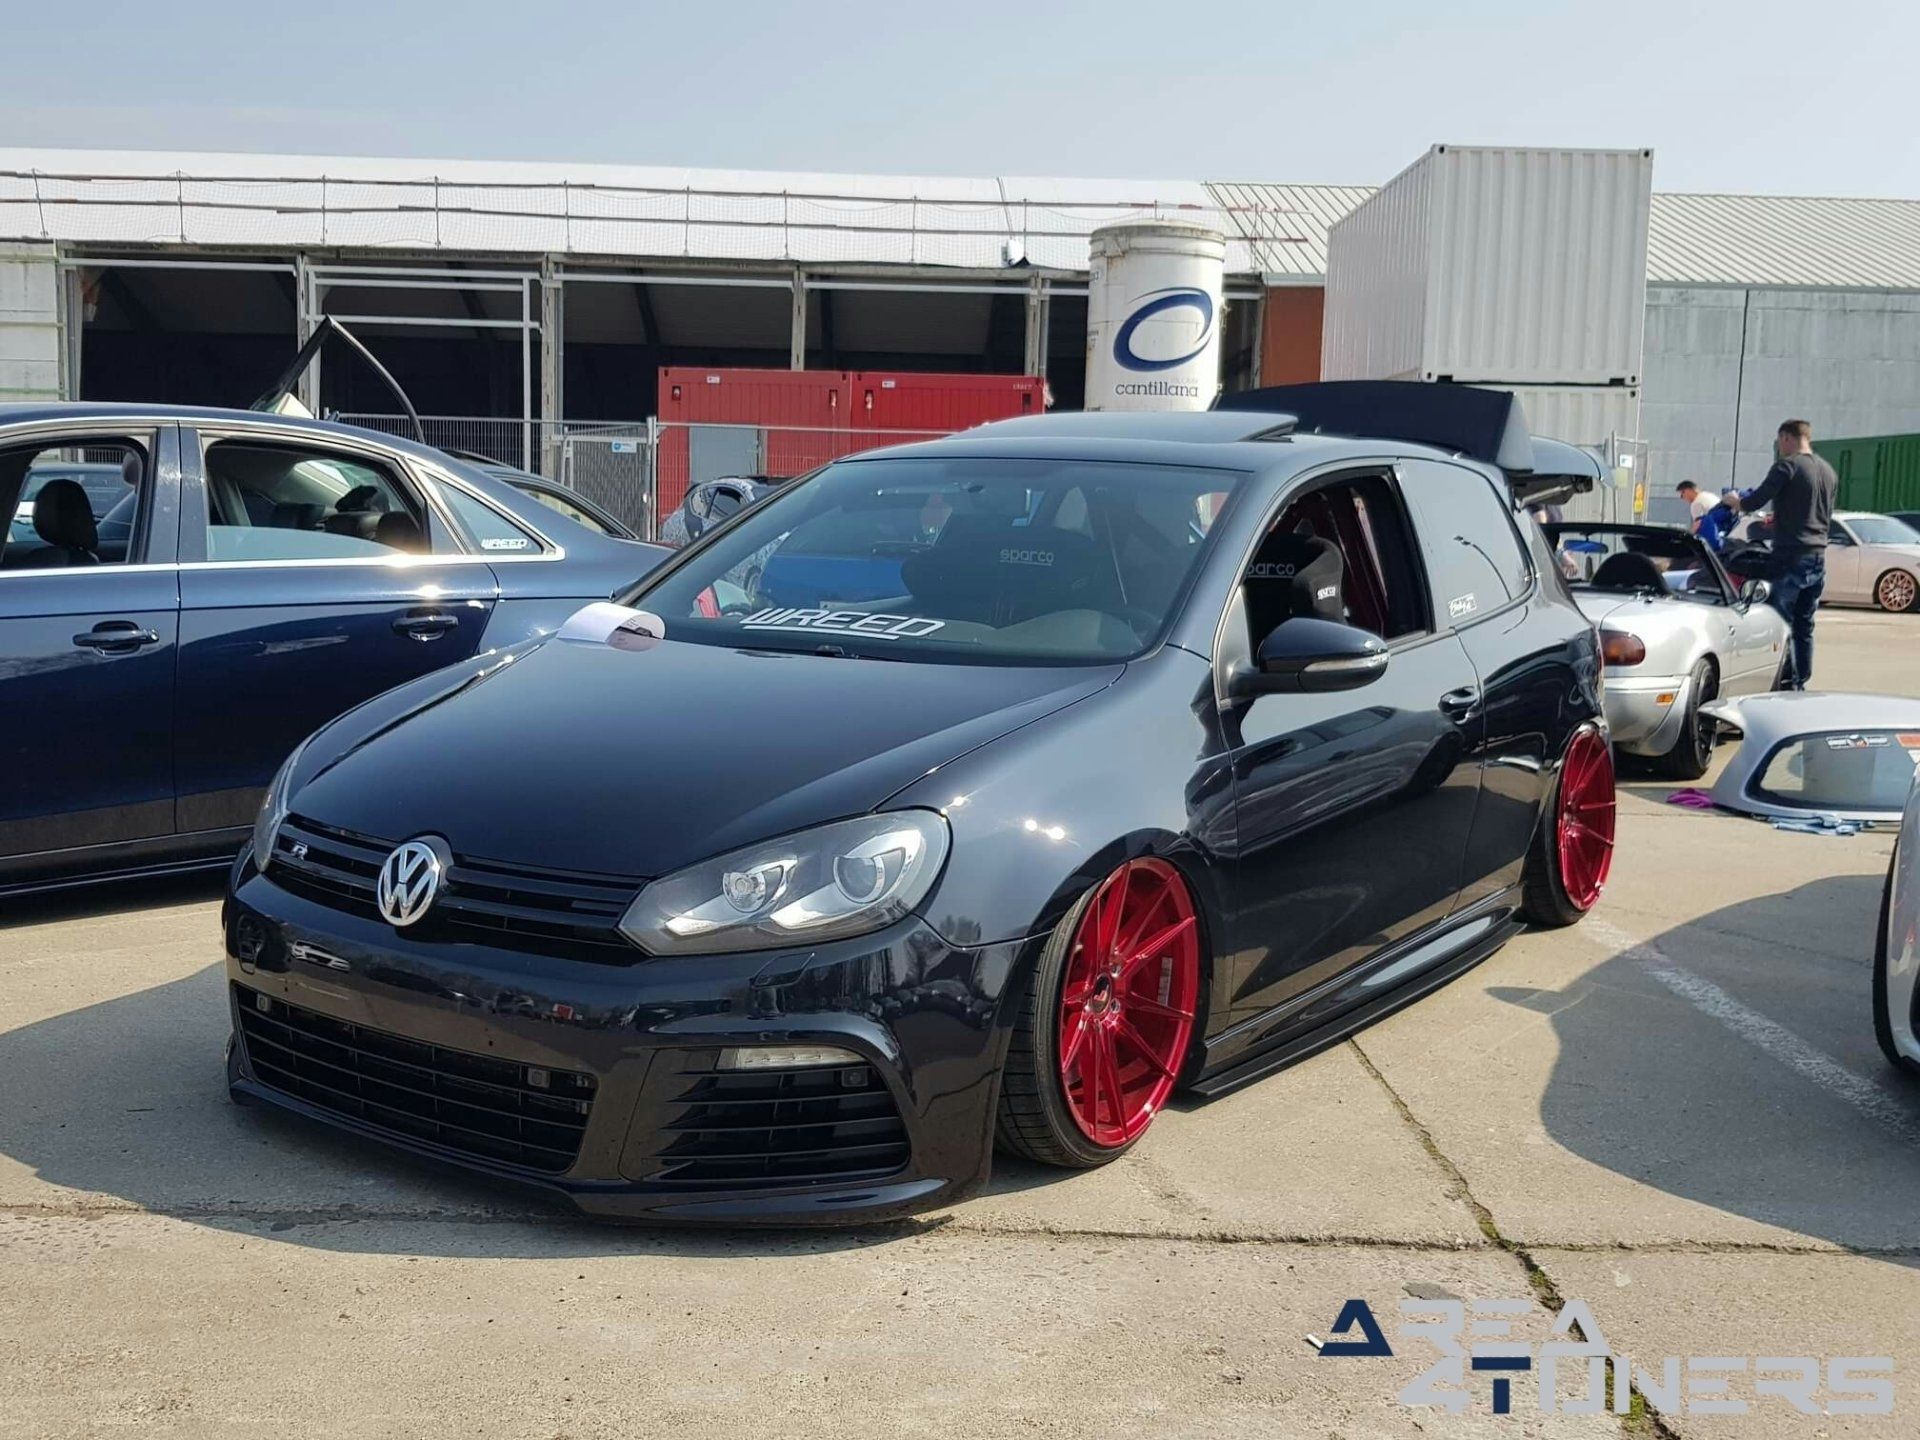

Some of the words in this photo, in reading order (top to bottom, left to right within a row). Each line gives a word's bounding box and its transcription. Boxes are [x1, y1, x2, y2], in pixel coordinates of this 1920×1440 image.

[1115, 381, 1198, 398] cantillana
[1000, 548, 1054, 565] sparco
[1246, 562, 1295, 577] parco
[739, 607, 946, 638] WREED
